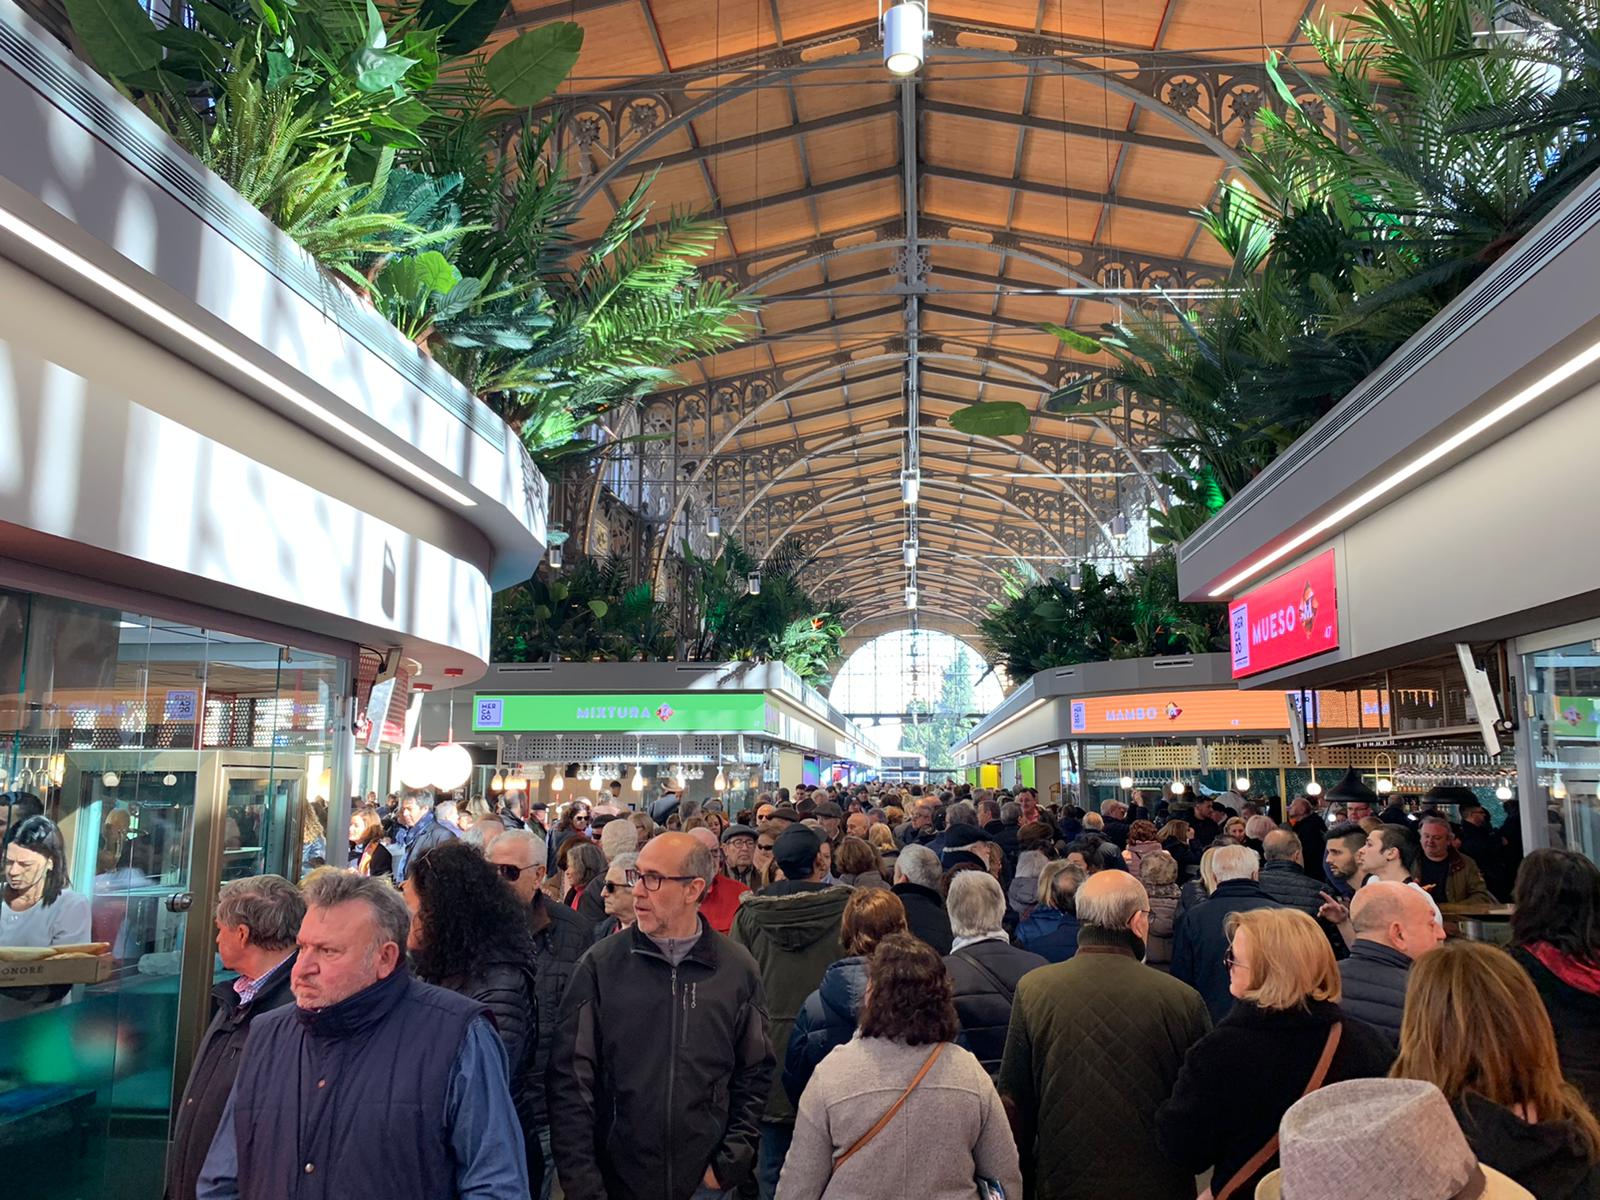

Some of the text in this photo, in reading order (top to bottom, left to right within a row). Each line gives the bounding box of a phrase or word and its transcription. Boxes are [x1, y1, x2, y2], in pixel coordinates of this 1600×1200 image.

[1252, 605, 1296, 646] MUESO
[576, 706, 651, 719] MIXTURA
[1106, 707, 1157, 721] MAMBO
